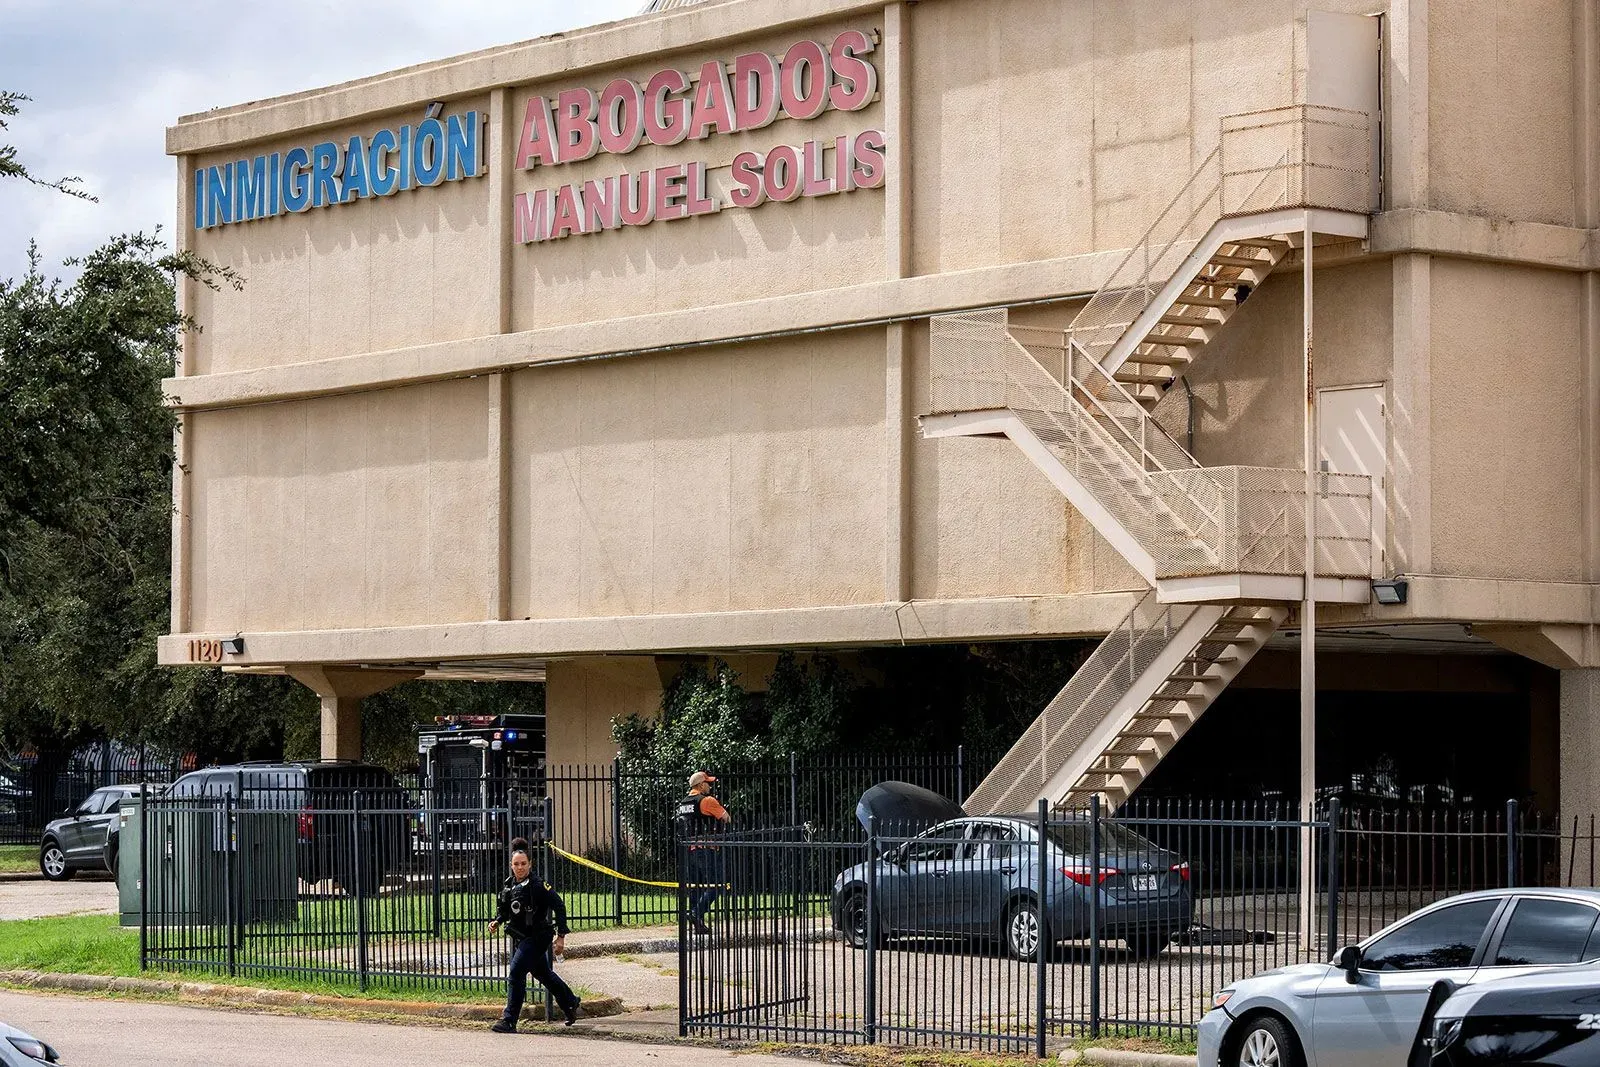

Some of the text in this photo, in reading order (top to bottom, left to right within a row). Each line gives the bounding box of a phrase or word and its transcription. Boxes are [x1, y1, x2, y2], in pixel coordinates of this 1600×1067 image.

[514, 29, 878, 171] ABOGADOS
[194, 102, 484, 230] INMIGRACIÓN
[513, 129, 886, 245] MANUEL SOLIS
[187, 639, 223, 662] 1120
